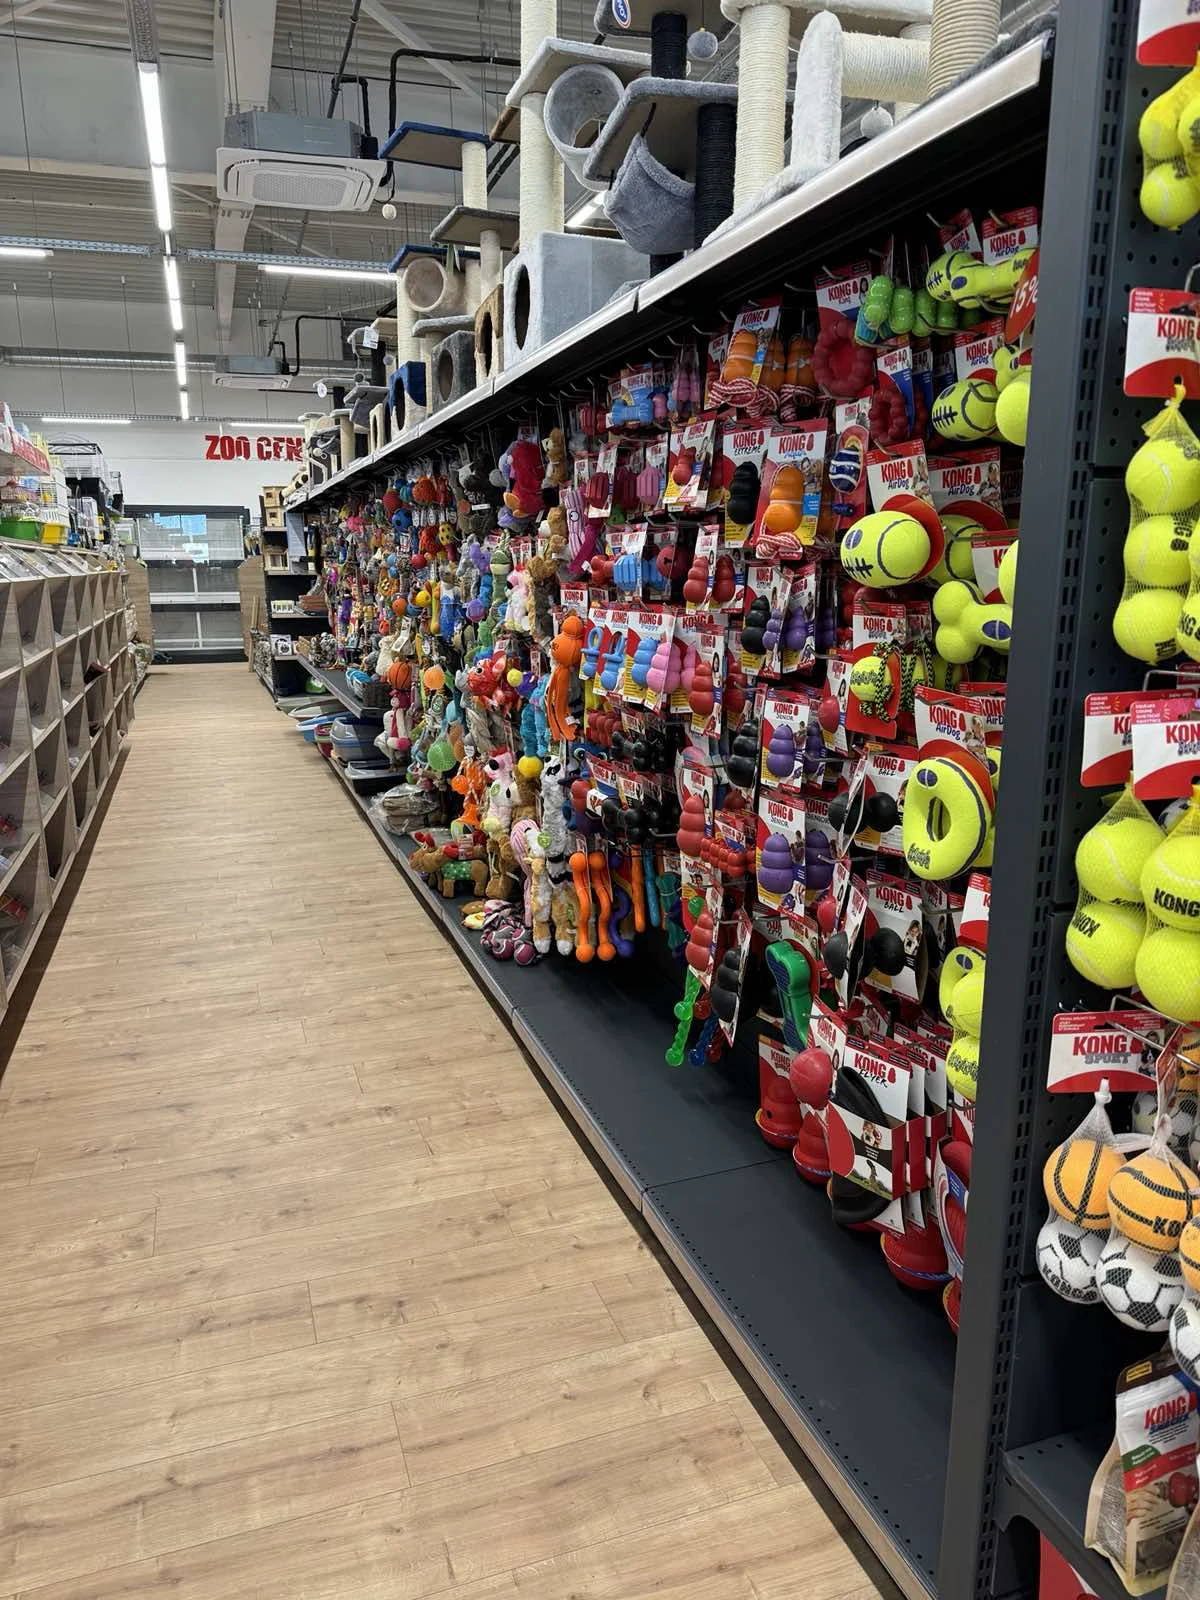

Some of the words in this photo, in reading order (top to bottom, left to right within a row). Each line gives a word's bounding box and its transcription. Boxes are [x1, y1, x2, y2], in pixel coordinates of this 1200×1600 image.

[989, 232, 1016, 253] KONG
[828, 281, 851, 301] KONG
[1157, 317, 1195, 338] KONG
[966, 344, 986, 361] KONG
[205, 435, 251, 460] ZOO
[733, 434, 756, 448] KONG
[779, 434, 805, 453] KONG
[881, 460, 907, 483] KONG
[942, 466, 973, 488] KONG
[888, 477, 910, 490] AirDog
[948, 483, 975, 496] AirDog
[639, 613, 657, 626] KONG
[863, 617, 886, 631] KONG
[773, 702, 793, 715] KONG
[929, 705, 958, 728] KONG
[936, 723, 961, 740] AirDog
[872, 755, 898, 771] KONG
[767, 801, 787, 820] KONG
[805, 800, 829, 816] KONG
[876, 886, 905, 907] KONG
[883, 901, 905, 913] BALL
[1072, 1035, 1127, 1056] KONG
[855, 1052, 887, 1079] KONG
[1084, 1051, 1132, 1064] SPORT
[859, 1068, 888, 1088] FLYER
[1144, 1396, 1187, 1430] KONG
